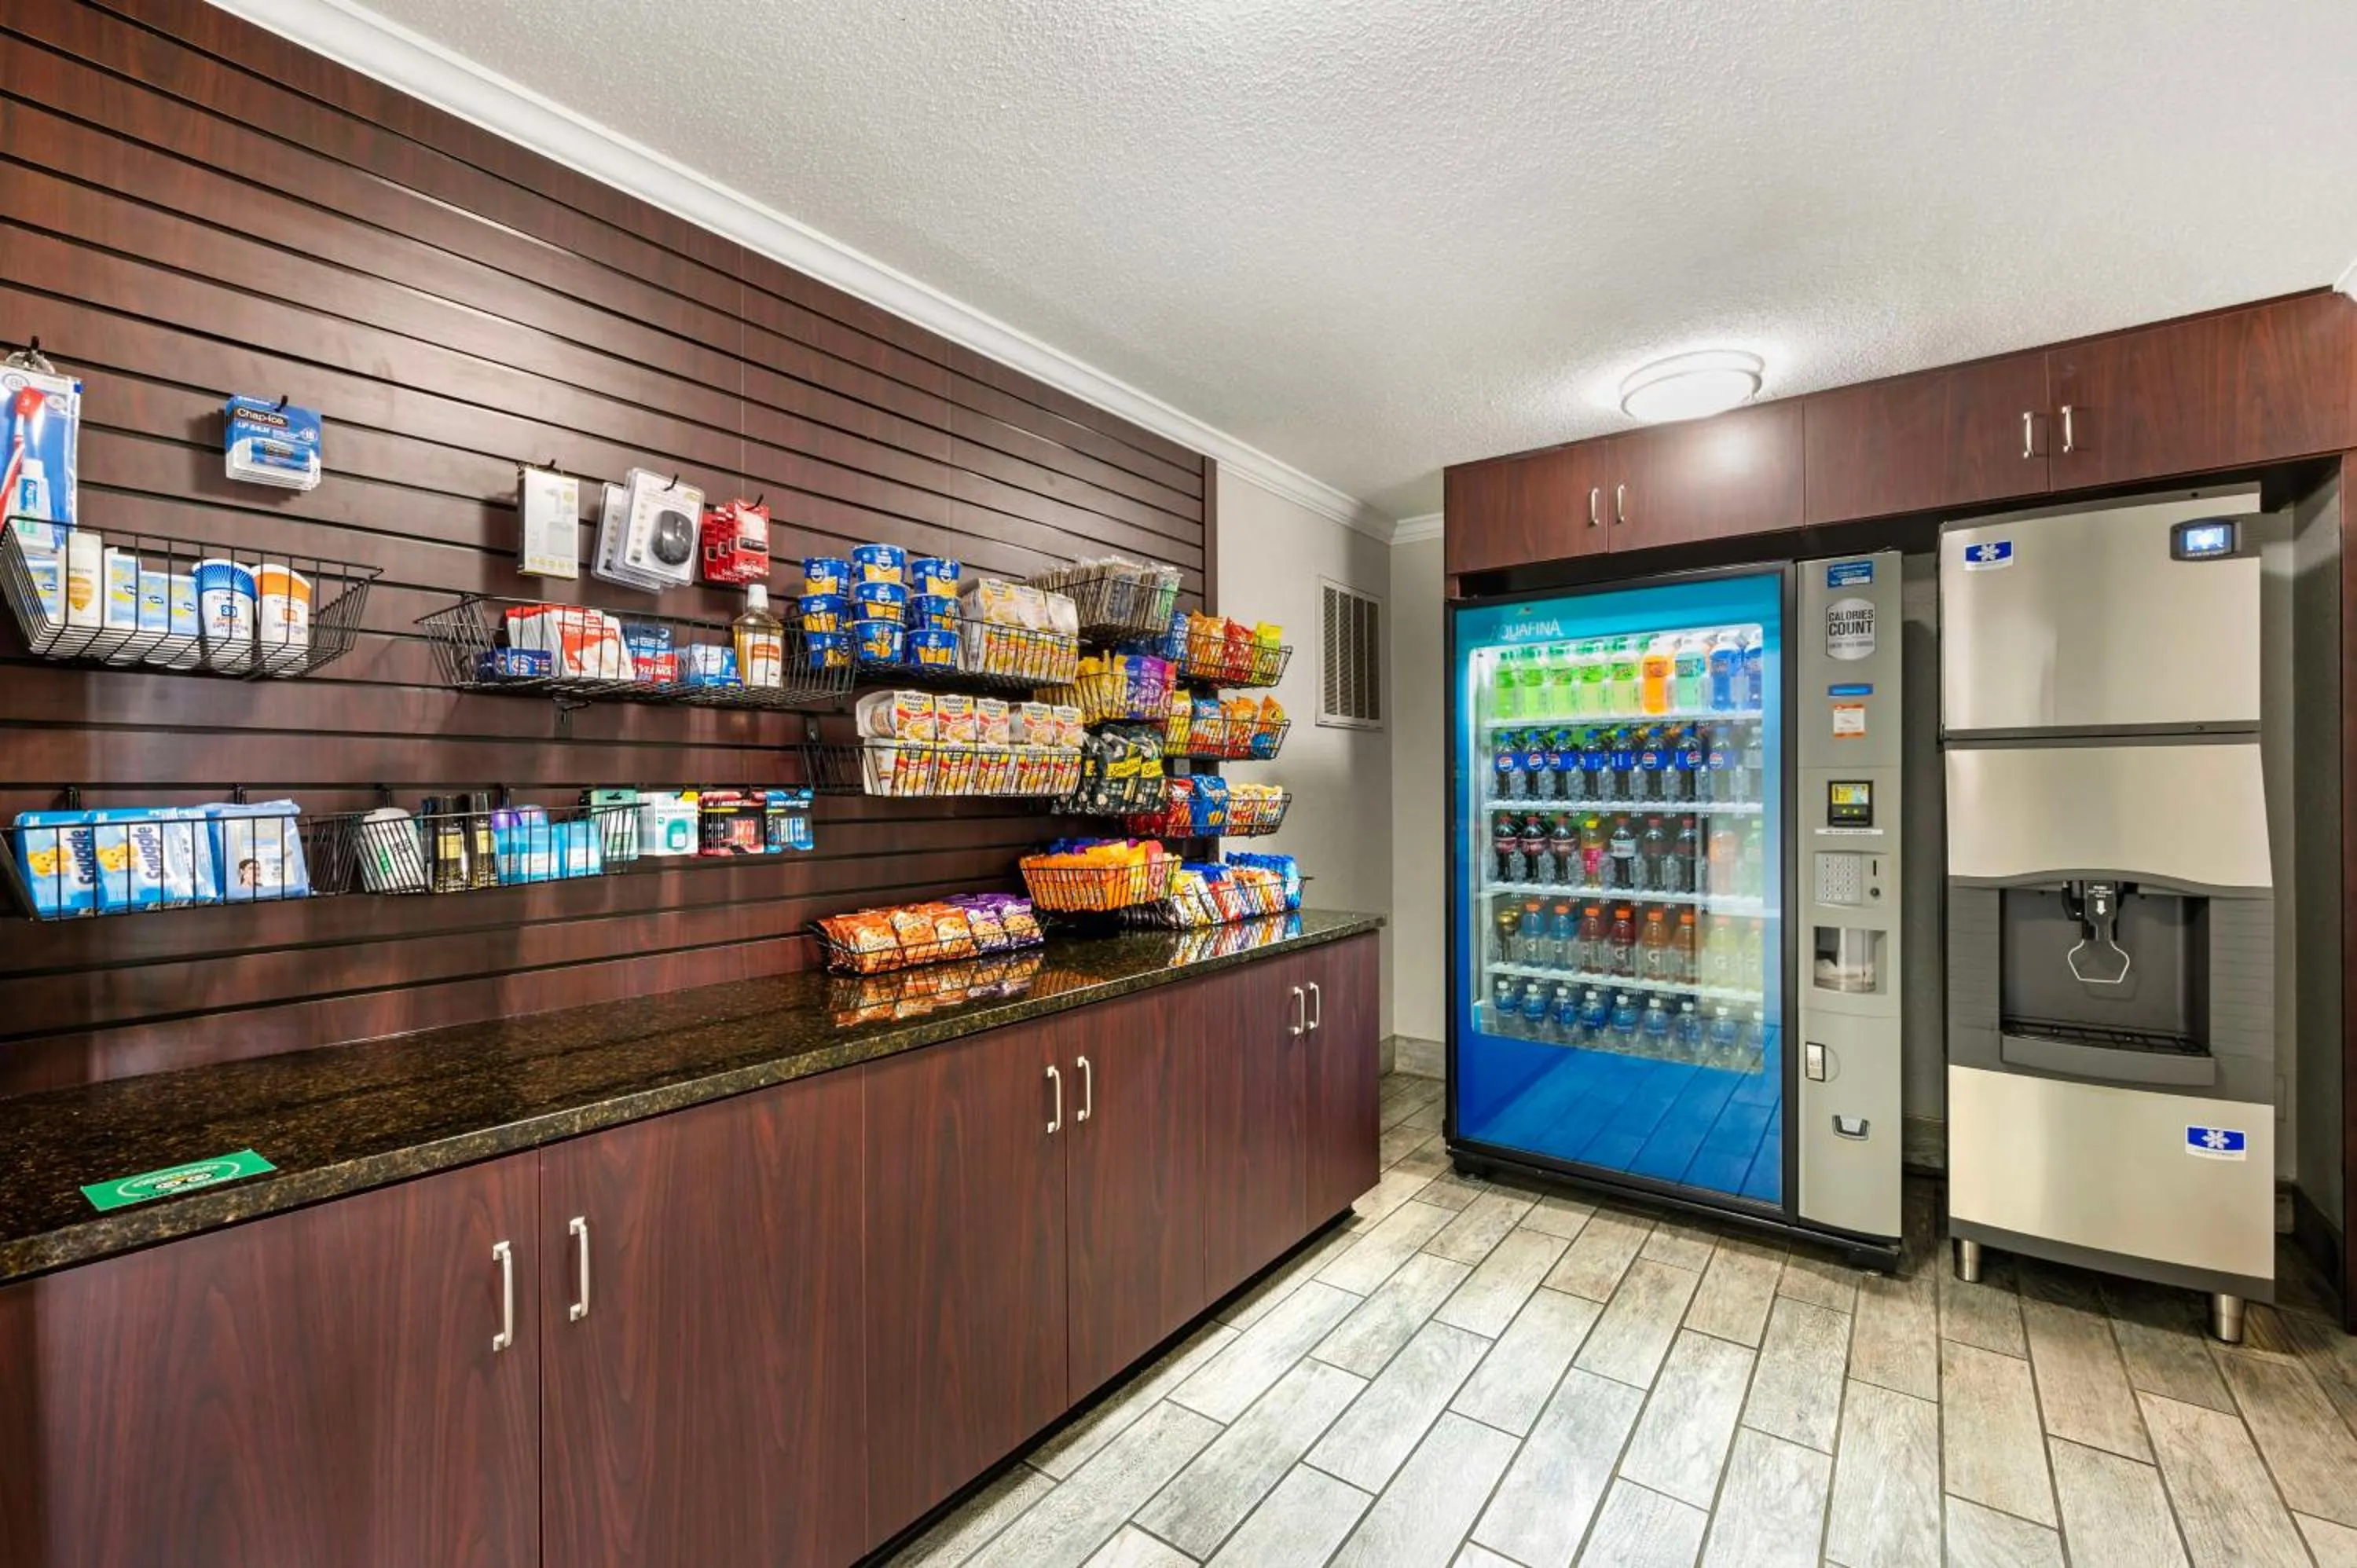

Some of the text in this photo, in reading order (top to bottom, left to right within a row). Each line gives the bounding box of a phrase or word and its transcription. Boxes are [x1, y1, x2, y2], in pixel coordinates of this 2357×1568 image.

[1828, 609, 1874, 623] CALORIES
[1490, 618, 1563, 641] QUAFINA
[1828, 620, 1874, 636] COUNT
